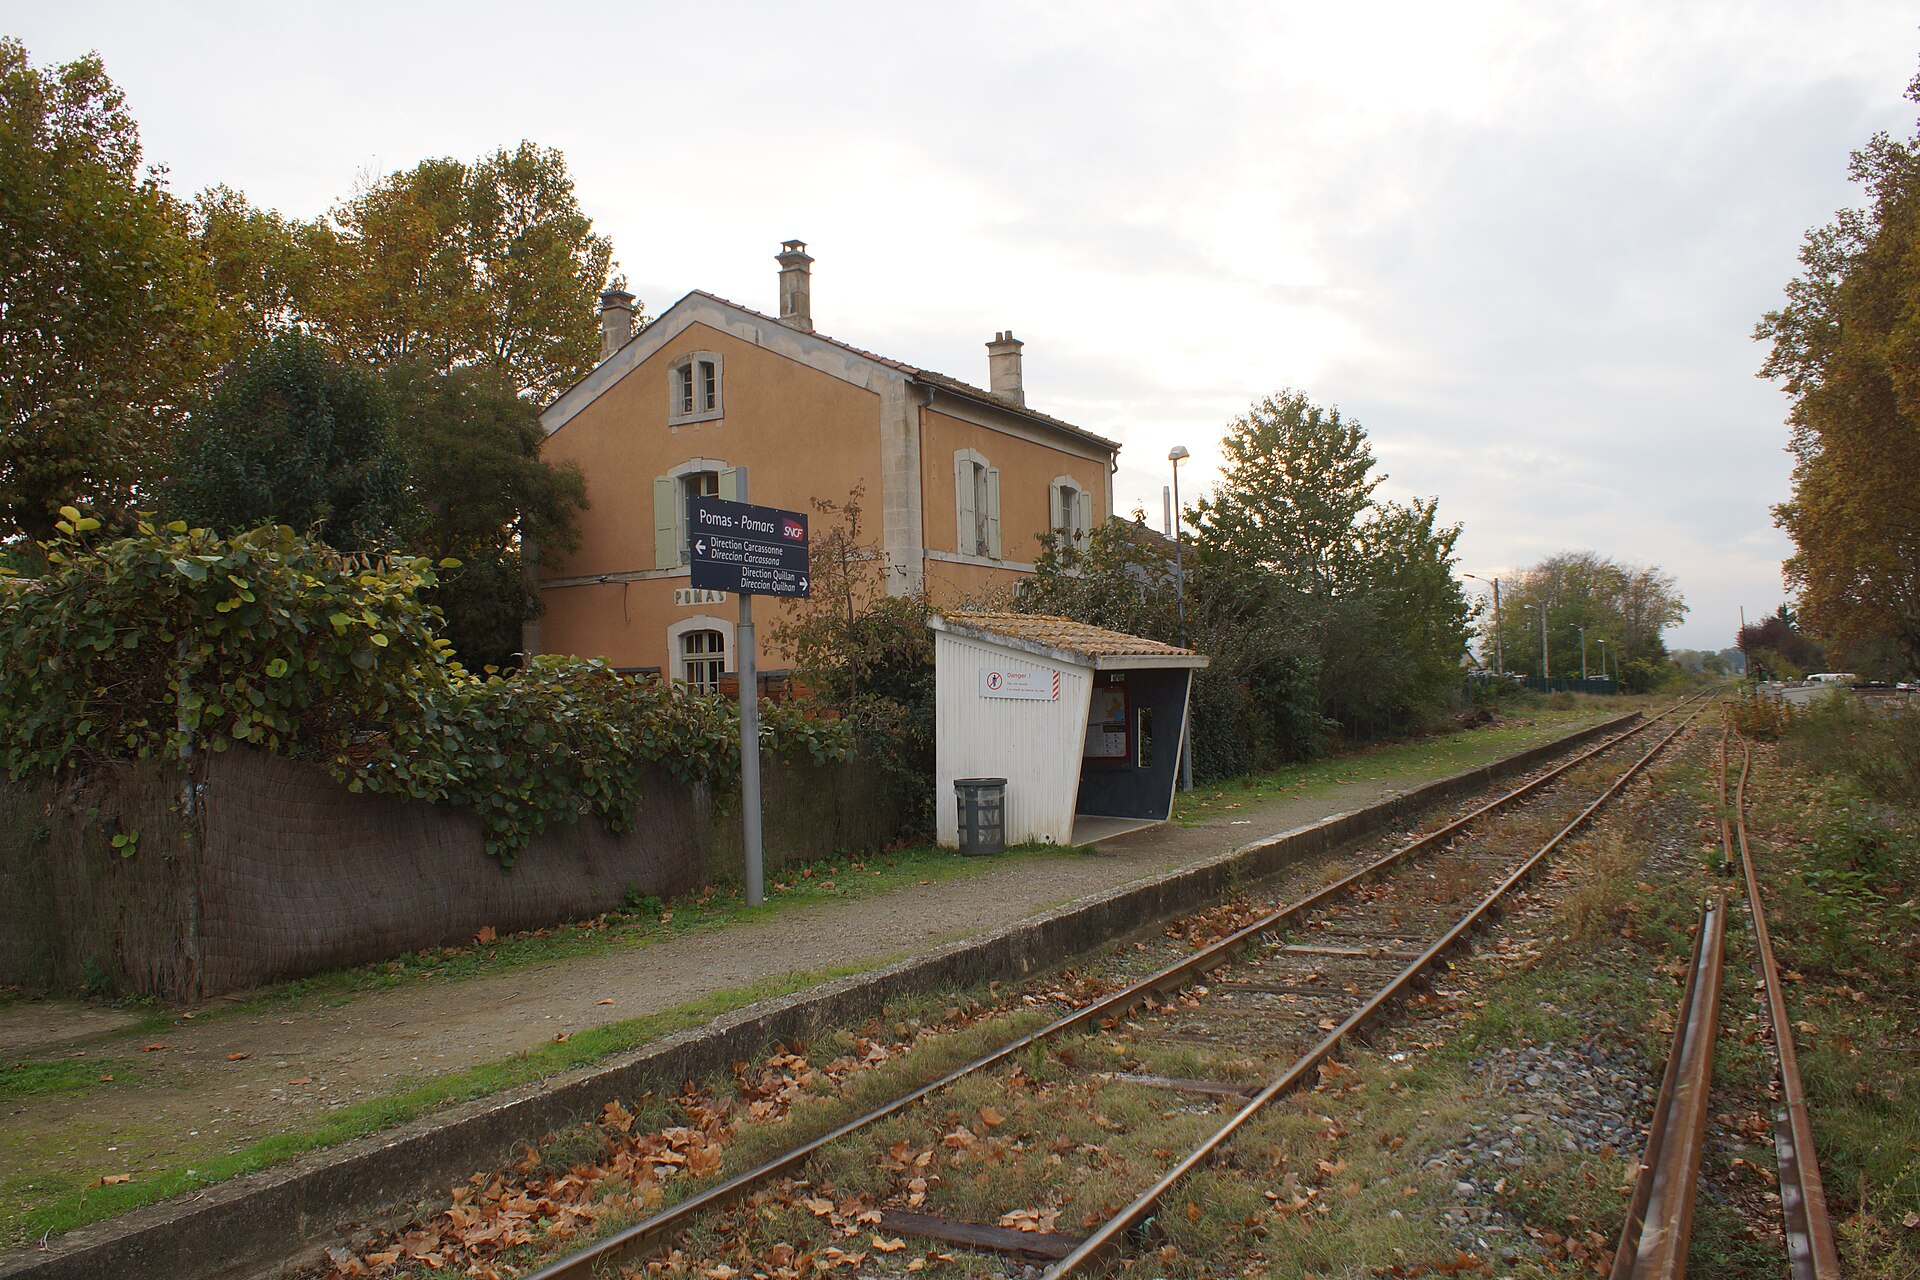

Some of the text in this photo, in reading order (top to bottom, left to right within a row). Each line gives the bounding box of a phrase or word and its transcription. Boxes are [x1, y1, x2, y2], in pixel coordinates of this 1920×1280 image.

[700, 508, 732, 527] Pomas
[741, 515, 775, 533] Pomars
[783, 526, 803, 538] SNCF
[710, 537, 784, 556] Direction Carcassonne
[711, 548, 780, 566] Direccion Carcassona
[742, 566, 795, 582] Direction Quillan
[740, 578, 796, 592] Direccion Quilhan
[675, 589, 725, 605] POMAS
